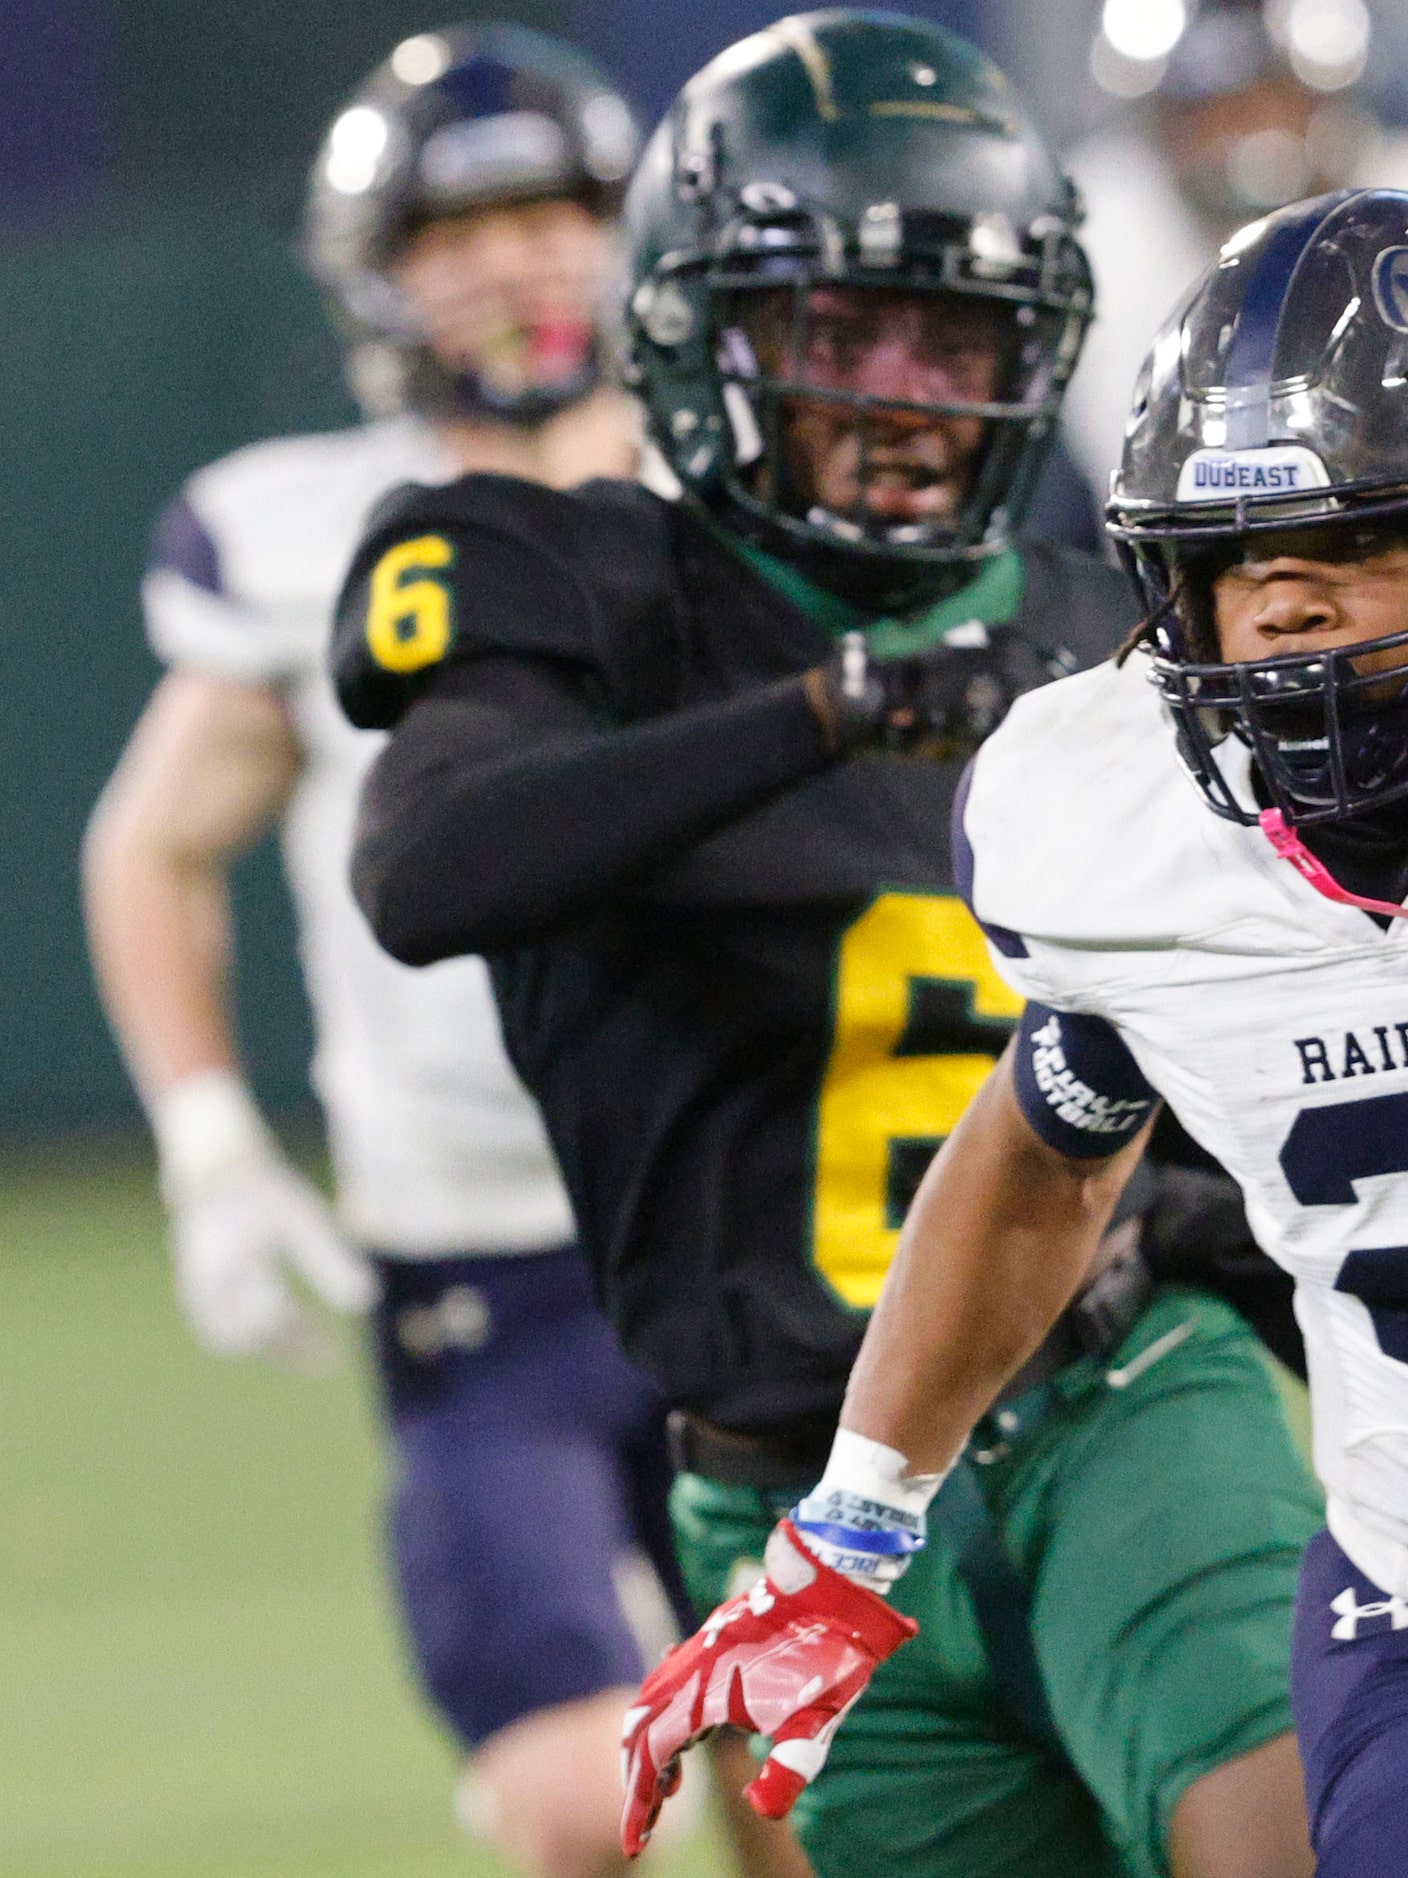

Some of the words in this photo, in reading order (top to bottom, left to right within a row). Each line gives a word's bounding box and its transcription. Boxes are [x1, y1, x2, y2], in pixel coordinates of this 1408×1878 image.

[1193, 457, 1300, 489] DUBEAST
[367, 534, 453, 674] 6
[812, 886, 1026, 1312] 6
